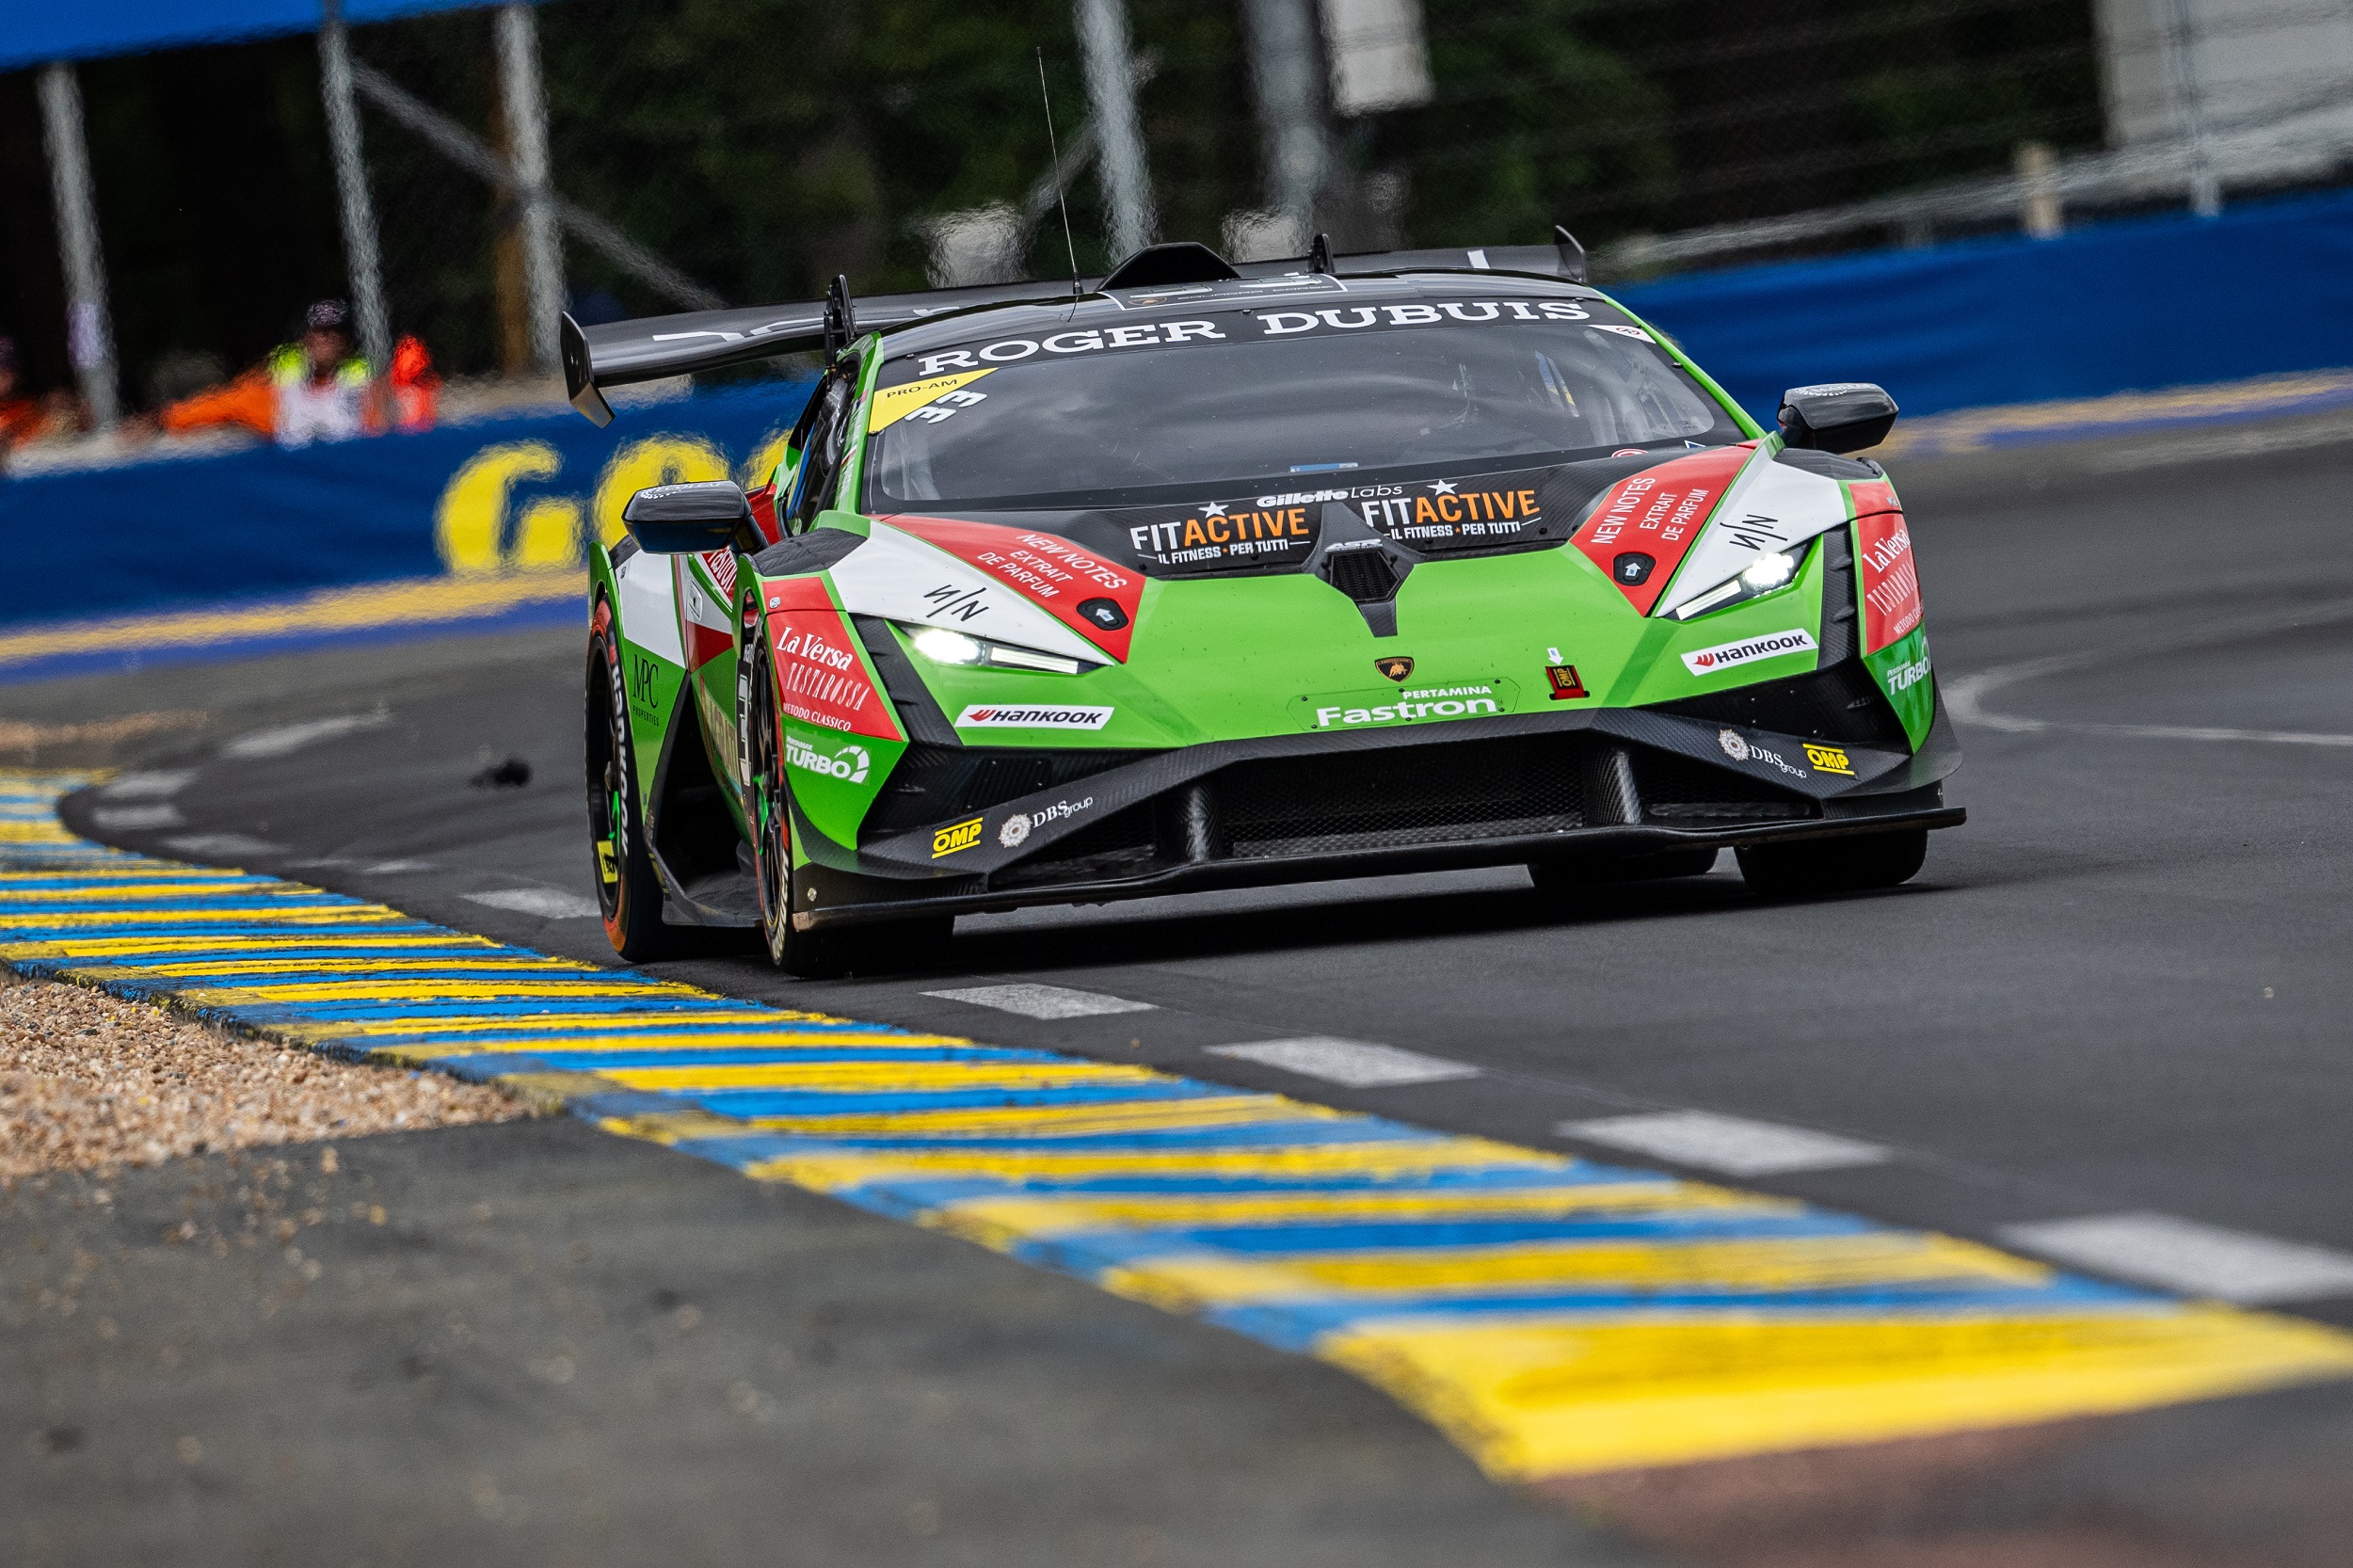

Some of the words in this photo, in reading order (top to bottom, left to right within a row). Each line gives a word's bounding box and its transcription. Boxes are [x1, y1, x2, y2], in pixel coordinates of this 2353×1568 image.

[919, 320, 1226, 376] ROGER
[1257, 302, 1591, 334] DUBUIS
[887, 378, 958, 398] PRO-AM
[1361, 489, 1541, 528] FITACTIVE
[1591, 516, 1623, 544] NEW
[1610, 477, 1656, 520] NOTES
[1639, 491, 1678, 530] EXTRAIT
[1661, 523, 1684, 541] DE
[1677, 488, 1709, 526] PARFUM
[1129, 507, 1309, 552] FITACTIVE
[1403, 524, 1454, 539] FITNESS
[1462, 521, 1486, 536] PER
[1487, 520, 1521, 534] TUTTI
[1009, 550, 1073, 583] EXTRAIT
[1016, 534, 1071, 554] NEW
[1057, 552, 1128, 589] NOTES
[1171, 546, 1222, 564] FITNESS
[1229, 541, 1255, 556] PER
[1255, 538, 1289, 553] TUTTI
[1862, 551, 1886, 574] La
[1875, 528, 1911, 558] Versa
[977, 552, 1005, 566] DE
[998, 562, 1060, 598] PARFUM
[776, 626, 800, 653] La
[800, 632, 853, 671] Versa
[632, 653, 659, 709] MPC
[787, 662, 871, 711] TESTAROSSA
[1402, 685, 1492, 699] PERTAMINA
[1556, 668, 1573, 687] OMP
[1888, 656, 1929, 696] TURBO
[782, 702, 810, 720] METODO
[810, 711, 851, 731] CLASSICO
[1317, 696, 1497, 727] Fastron
[786, 744, 851, 778] TURBO
[1805, 746, 1851, 772] OMP
[932, 821, 984, 854] OMP
